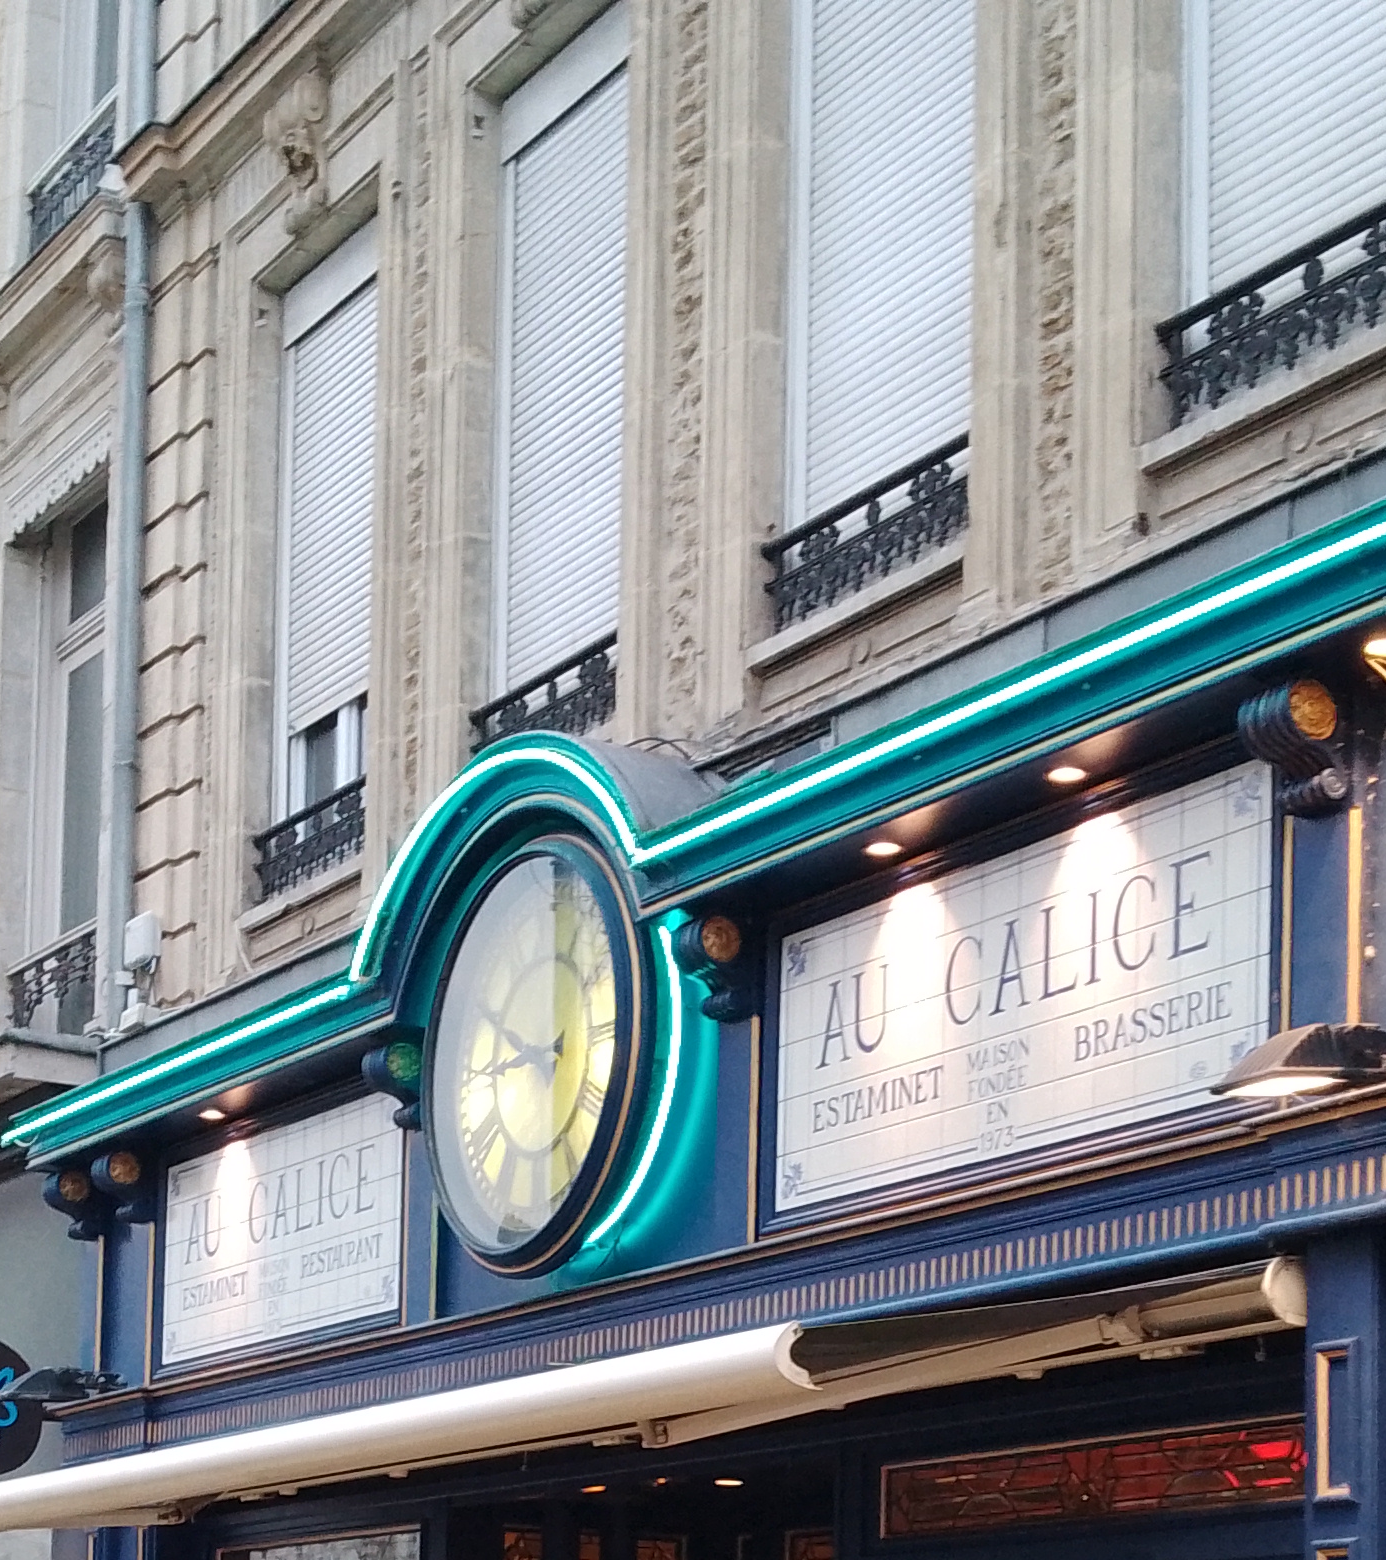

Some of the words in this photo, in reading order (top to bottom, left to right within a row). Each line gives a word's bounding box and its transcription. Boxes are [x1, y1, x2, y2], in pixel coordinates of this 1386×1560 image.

[815, 963, 890, 1071] AU
[944, 850, 1214, 1027] CALICE
[1073, 980, 1233, 1064] BRASSERIE
[965, 1034, 1030, 1076] MAISON
[811, 1064, 944, 1134] ESTAMINET
[966, 1063, 1029, 1103] FONDÉE
[986, 1099, 1010, 1125] EN
[978, 1124, 1015, 1154] 1973
[184, 1194, 222, 1266] AU
[248, 1142, 376, 1245] CALICE
[299, 1231, 384, 1280] RESTAURANT
[182, 1270, 249, 1312] ESTAMINET
